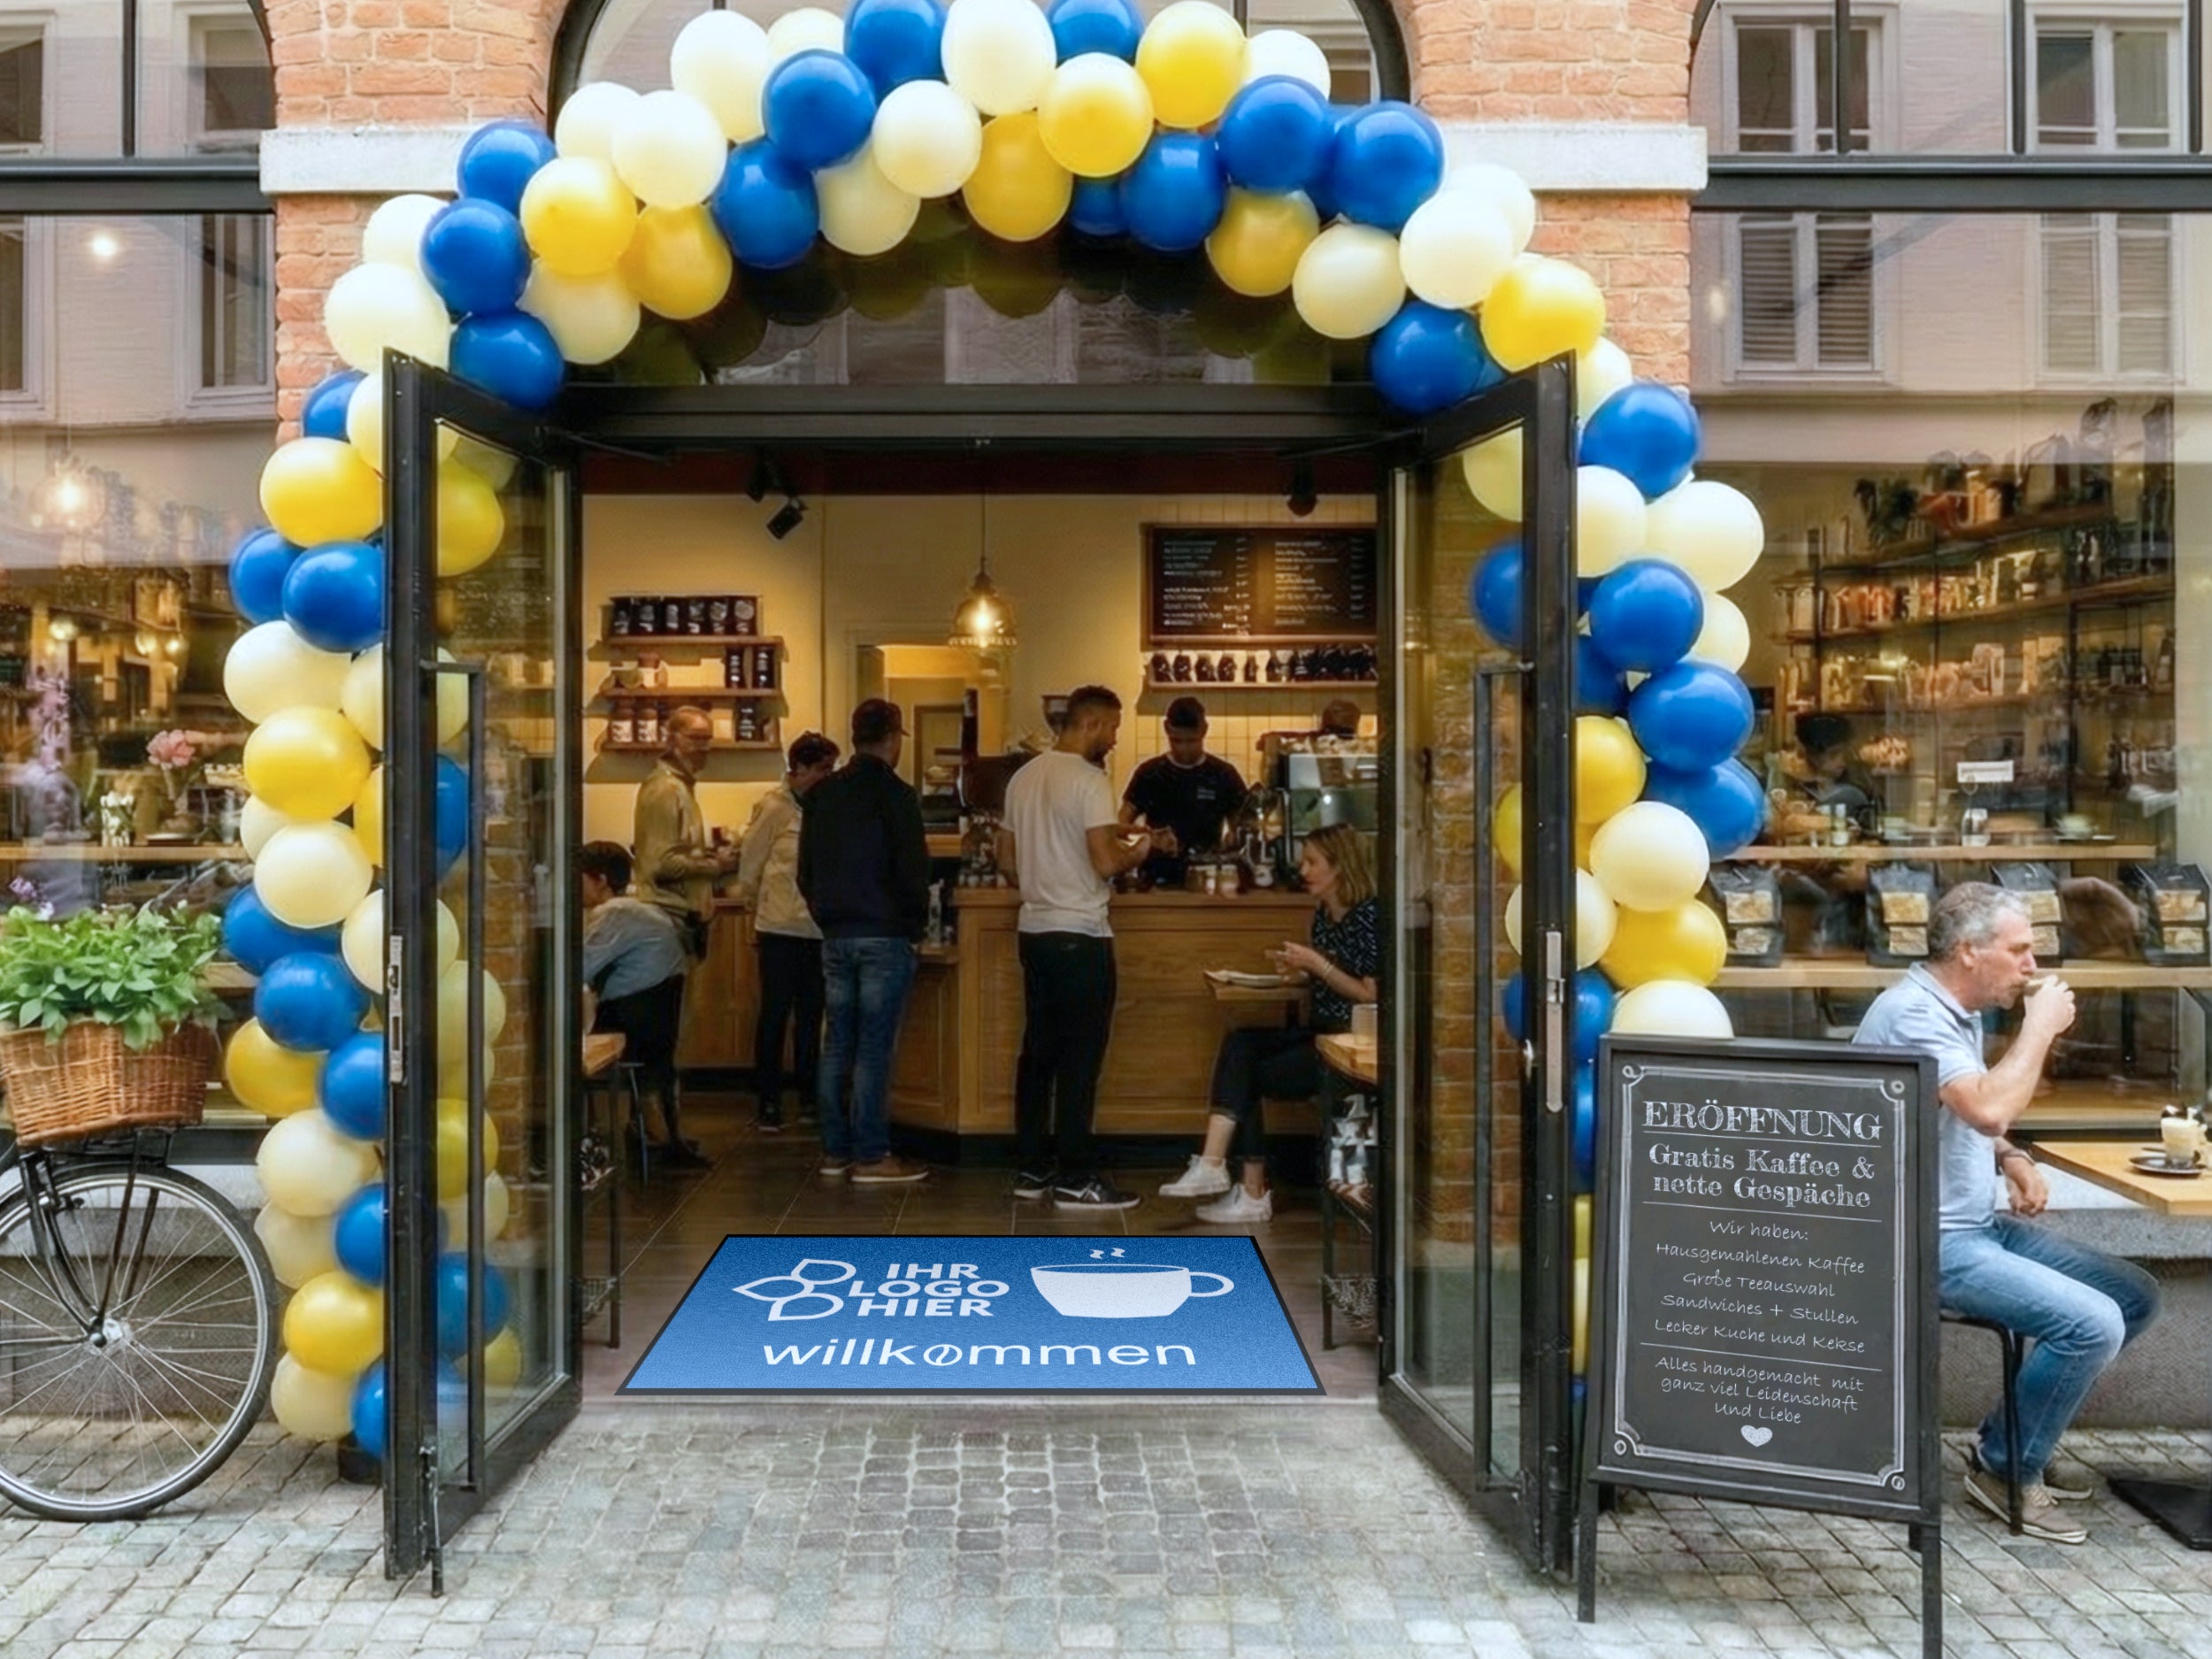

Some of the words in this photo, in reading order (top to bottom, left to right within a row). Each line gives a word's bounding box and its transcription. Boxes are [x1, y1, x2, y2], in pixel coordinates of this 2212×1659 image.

[1641, 1099, 1883, 1141] ERÖFFNUNG
[1649, 1143, 1735, 1171] Gratis
[1745, 1148, 1840, 1178] Kaffee
[1852, 1156, 1875, 1179] &
[1654, 1175, 1723, 1196] nette
[1733, 1176, 1870, 1208] Gespäche
[1709, 1220, 1744, 1235] Wir
[1751, 1222, 1809, 1240] haben:
[886, 1263, 981, 1280] IHR
[1656, 1243, 1802, 1267] Hausgemahlenen
[1808, 1256, 1865, 1276] Kaffee
[848, 1280, 1011, 1298] LOGO
[1683, 1269, 1732, 1287] Große
[1736, 1276, 1835, 1297] Teeauswahl
[856, 1298, 995, 1317] HIER
[1660, 1294, 1763, 1316] Sandwiches
[1770, 1304, 1783, 1317] +
[1790, 1307, 1859, 1325] Stullen
[1655, 1319, 1709, 1336] Lecker
[1771, 1332, 1806, 1346] und
[1813, 1336, 1865, 1354] Kekse
[761, 1339, 1196, 1366] willkommen
[1655, 1357, 1697, 1372] Alles
[1702, 1361, 1821, 1387] handgemacht
[1832, 1378, 1864, 1393] mit
[1661, 1378, 1705, 1393] ganz
[1709, 1381, 1740, 1396] viel
[1746, 1386, 1859, 1415] Leidenschaft
[1758, 1406, 1801, 1424] Liebe
